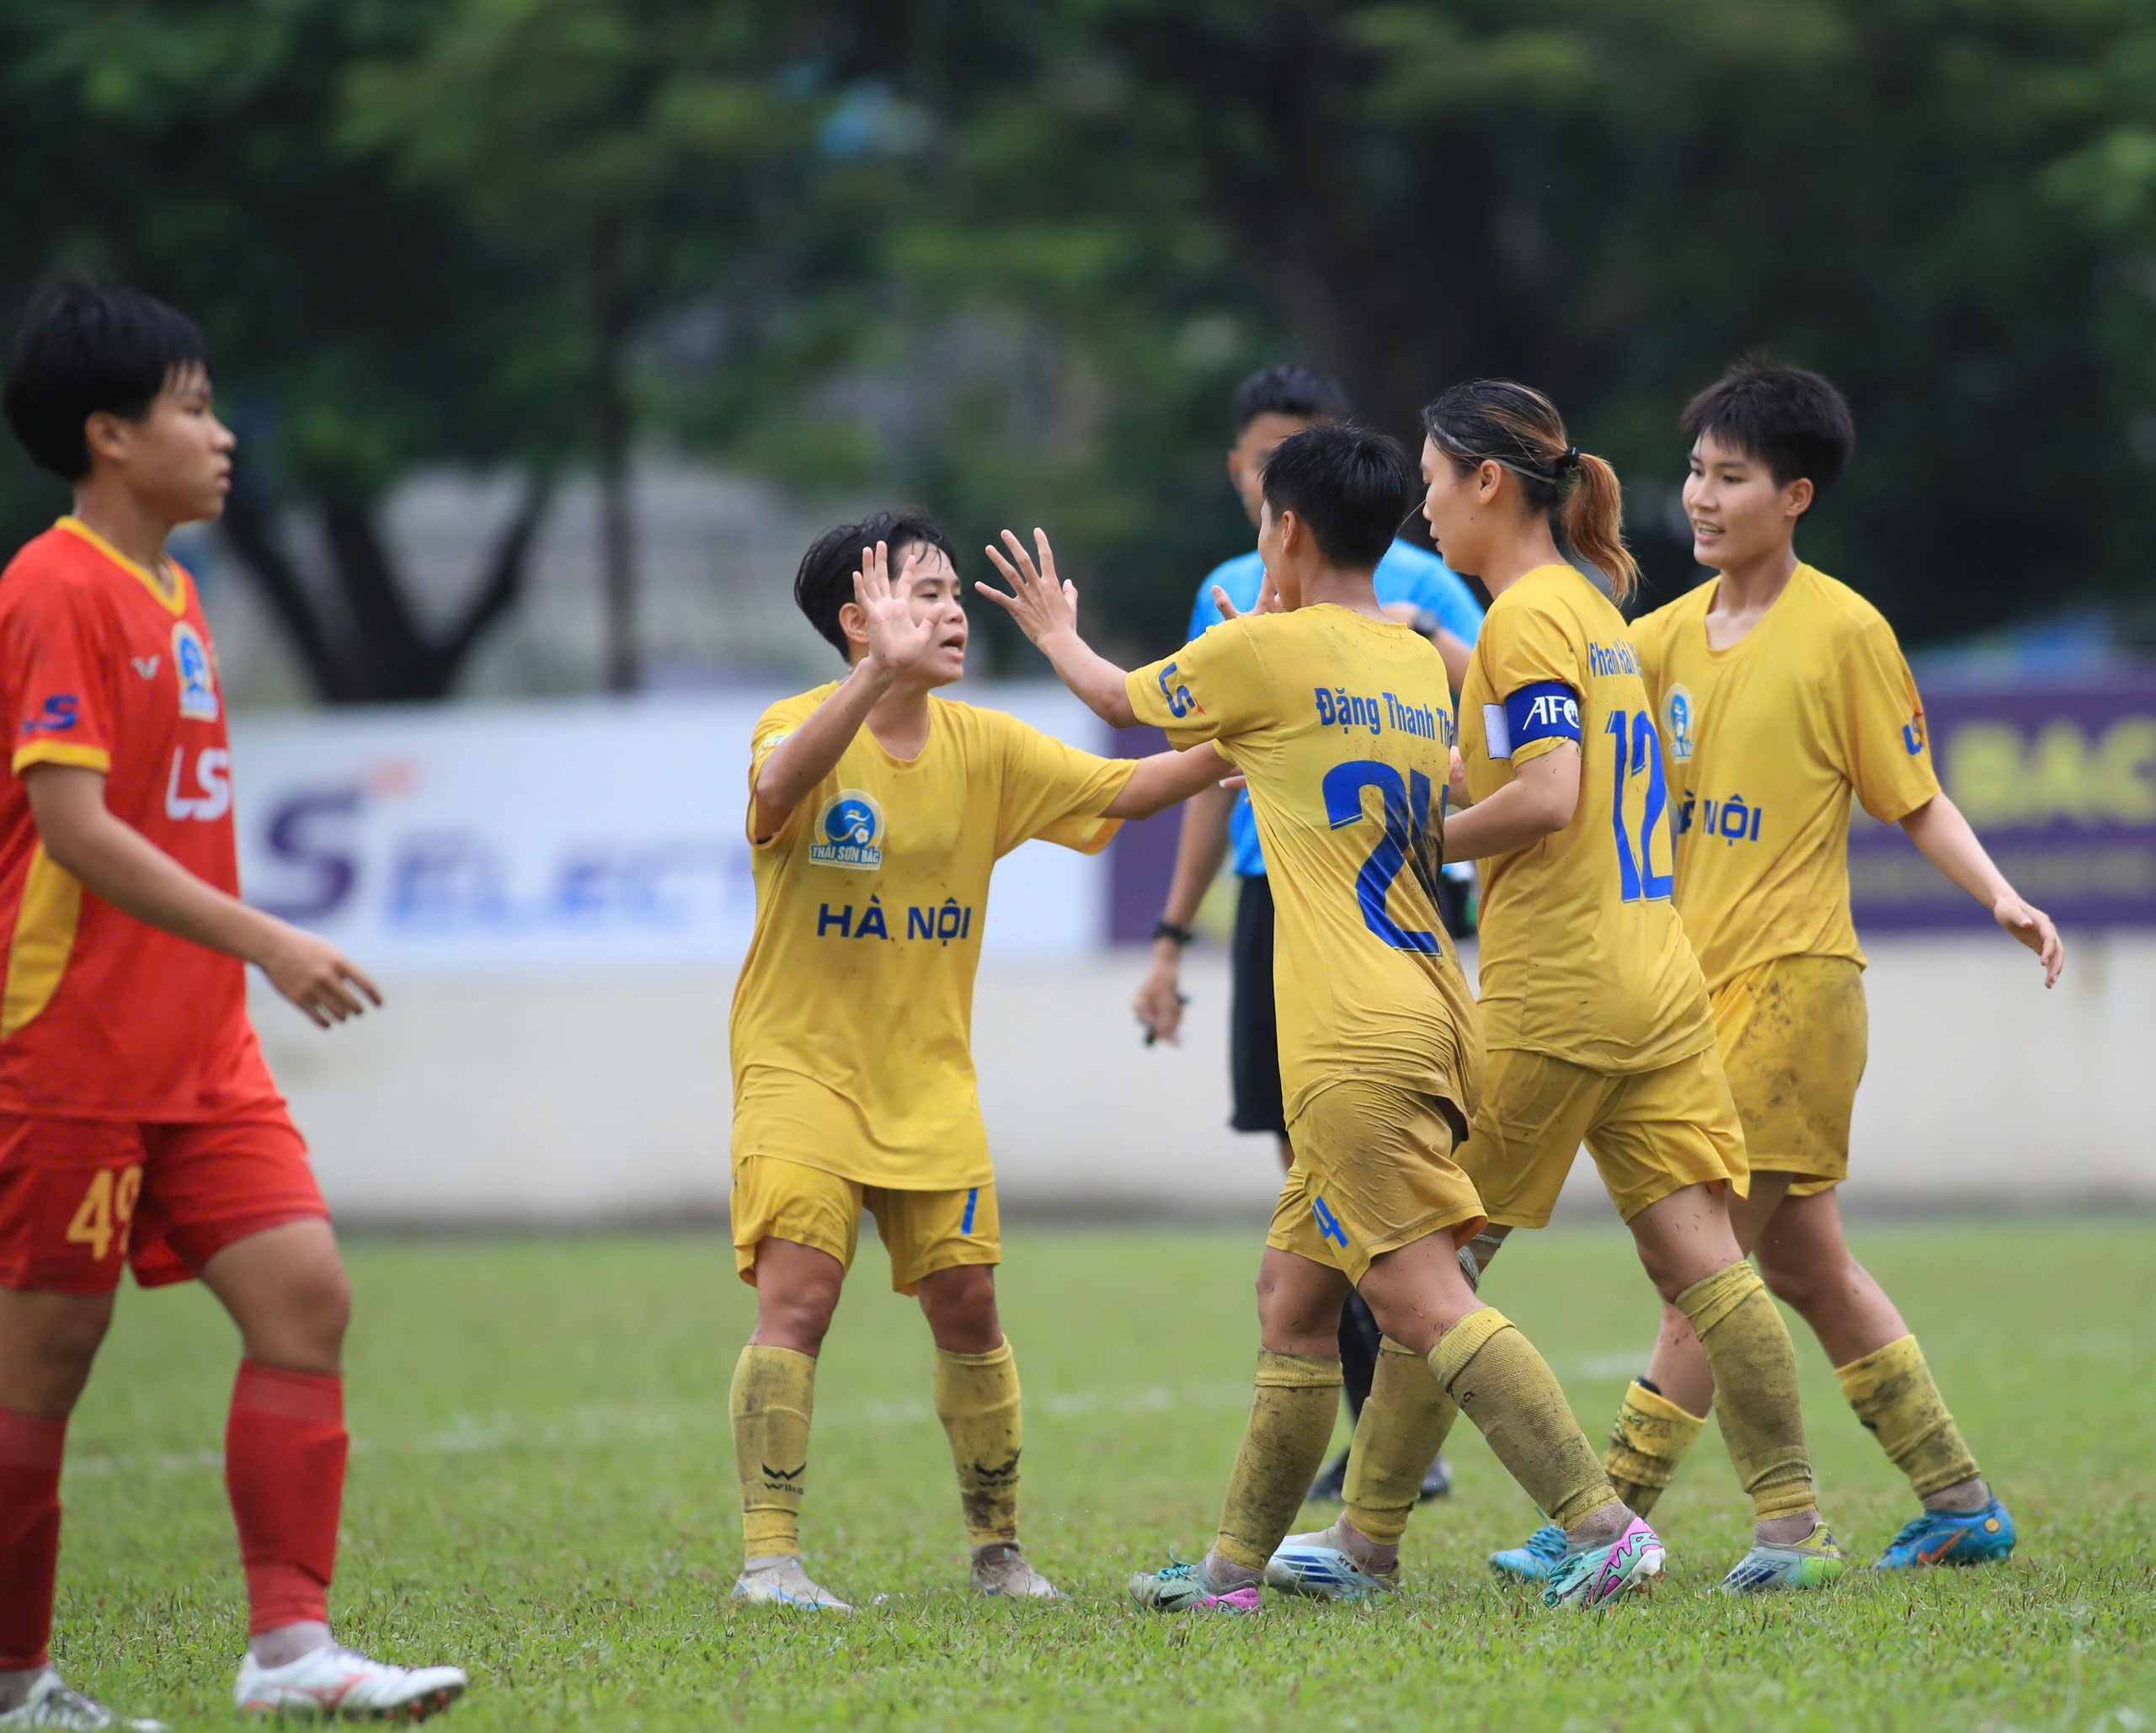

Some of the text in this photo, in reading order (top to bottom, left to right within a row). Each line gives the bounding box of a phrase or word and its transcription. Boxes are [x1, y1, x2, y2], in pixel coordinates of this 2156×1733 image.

[1159, 661, 1196, 718] LS
[1315, 687, 1381, 735] Đặng
[1382, 691, 1435, 740] Thanh
[1604, 711, 1673, 904] 12
[1702, 793, 1763, 847] NỘI
[817, 893, 972, 946] HÀ NỘI
